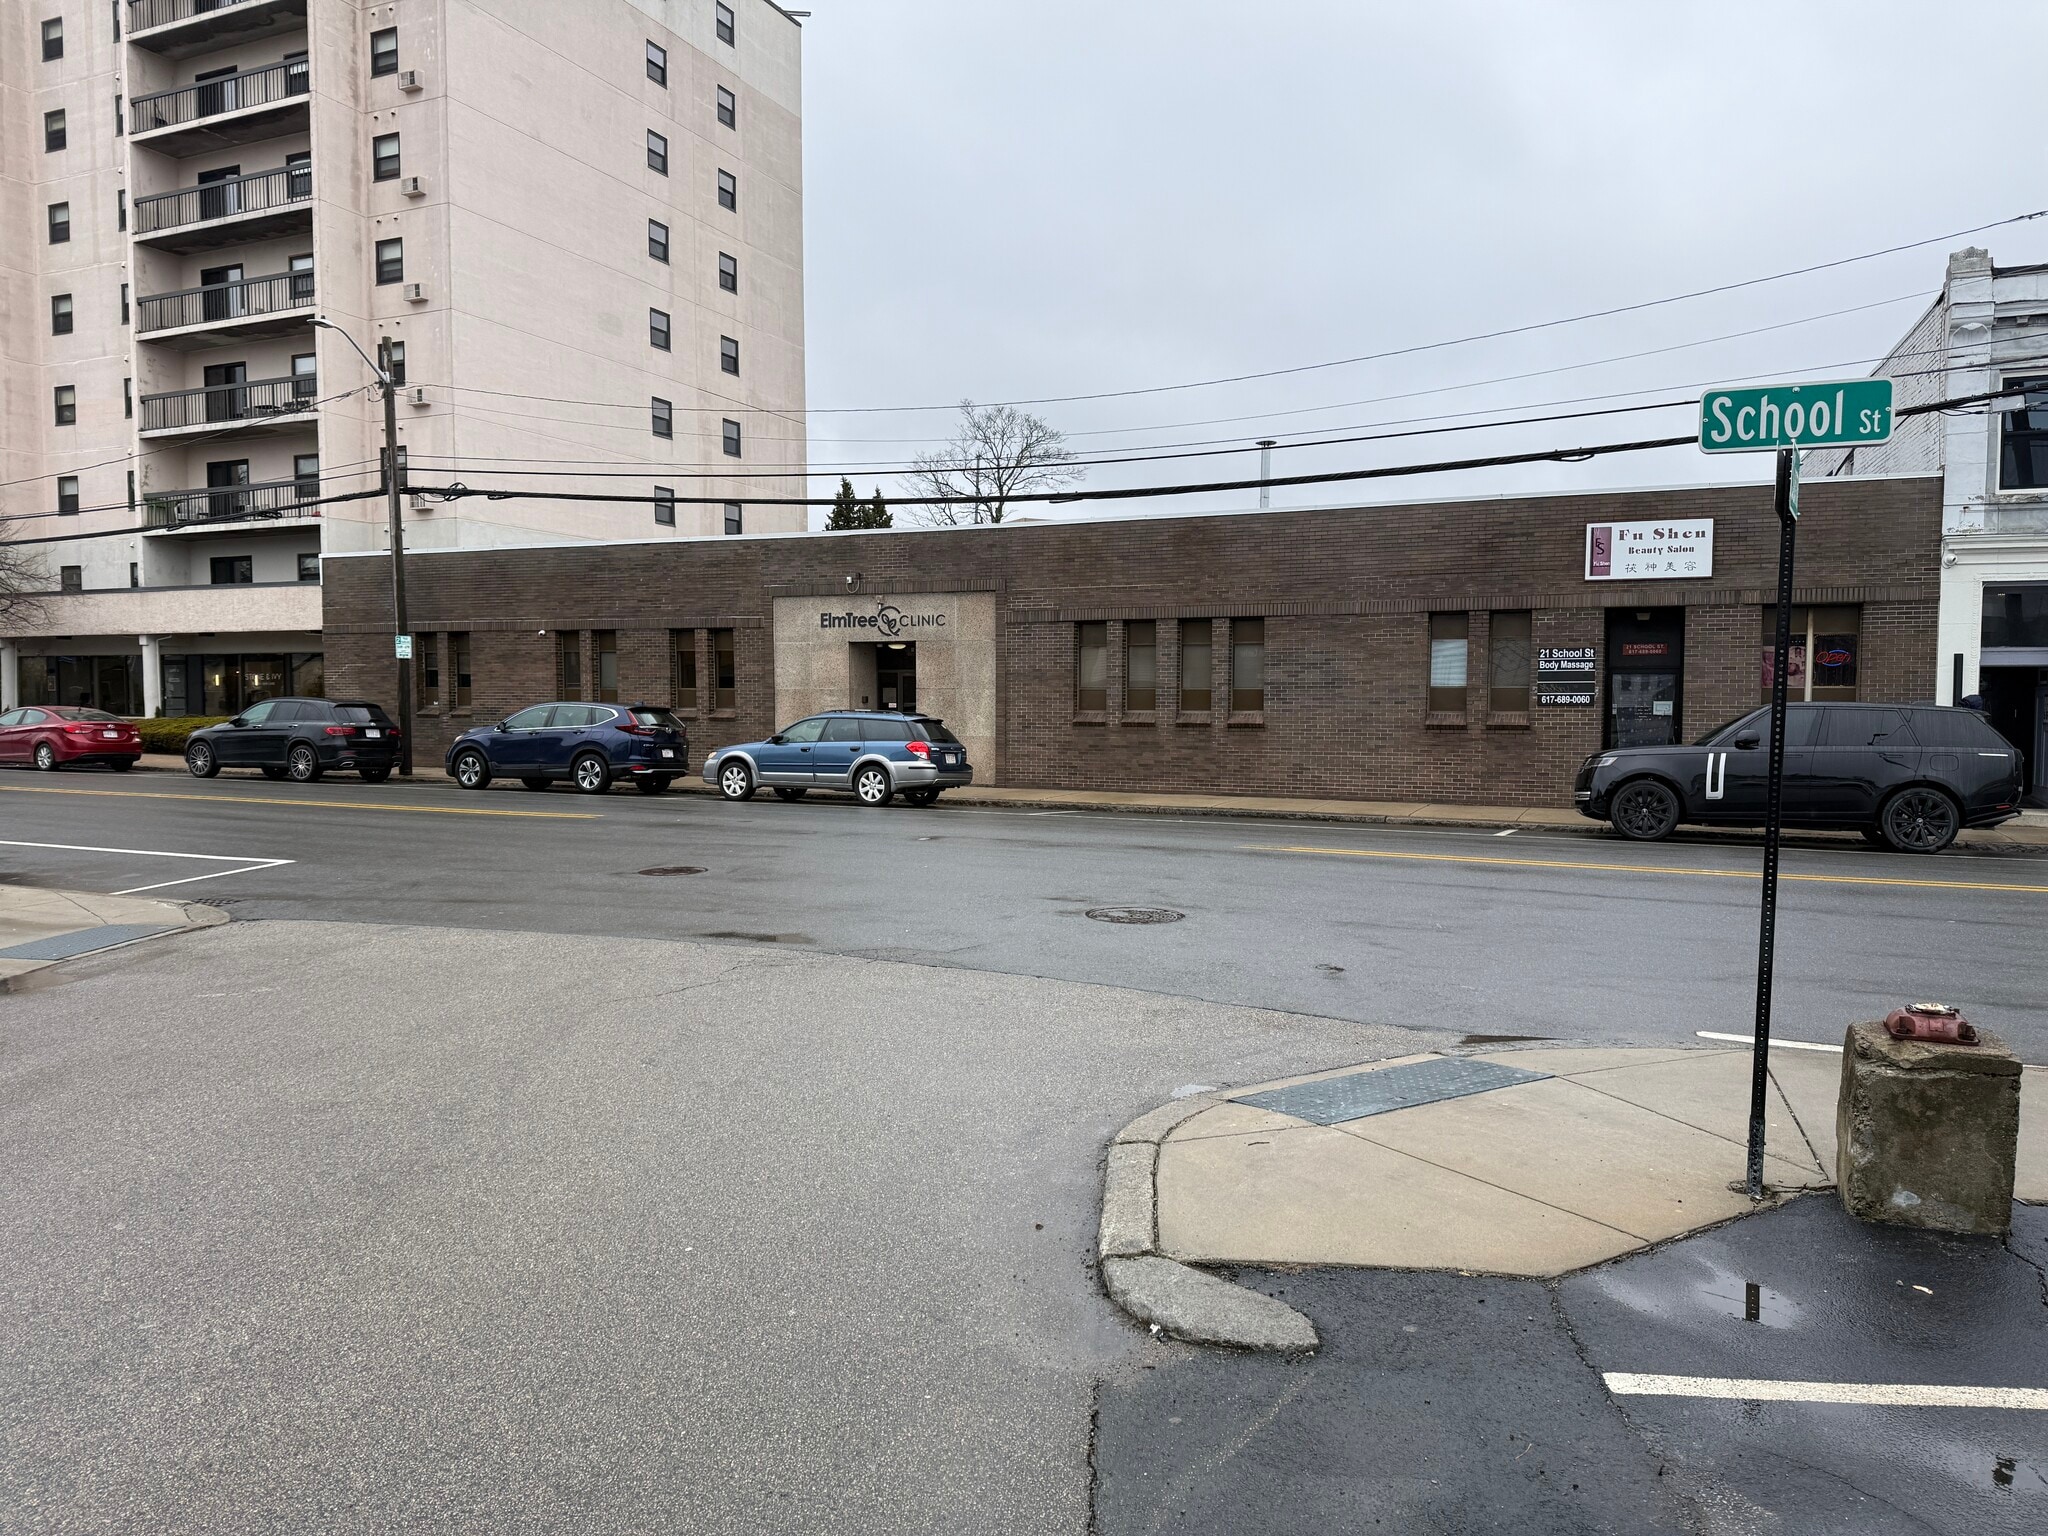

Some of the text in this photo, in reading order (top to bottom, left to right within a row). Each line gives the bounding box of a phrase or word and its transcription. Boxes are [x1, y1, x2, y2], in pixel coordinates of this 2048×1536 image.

[1710, 389, 1882, 443] School St
[1619, 527, 1706, 541] Fu Shen
[1628, 544, 1695, 556] Beauty Salon
[820, 612, 946, 629] ElmTree CLINIC
[1539, 648, 1594, 658] 21 School St
[1816, 651, 1851, 663] Open
[1539, 660, 1594, 670] Body Massage
[244, 673, 265, 681] STOE
[1541, 695, 1590, 704] 617-689-0060
